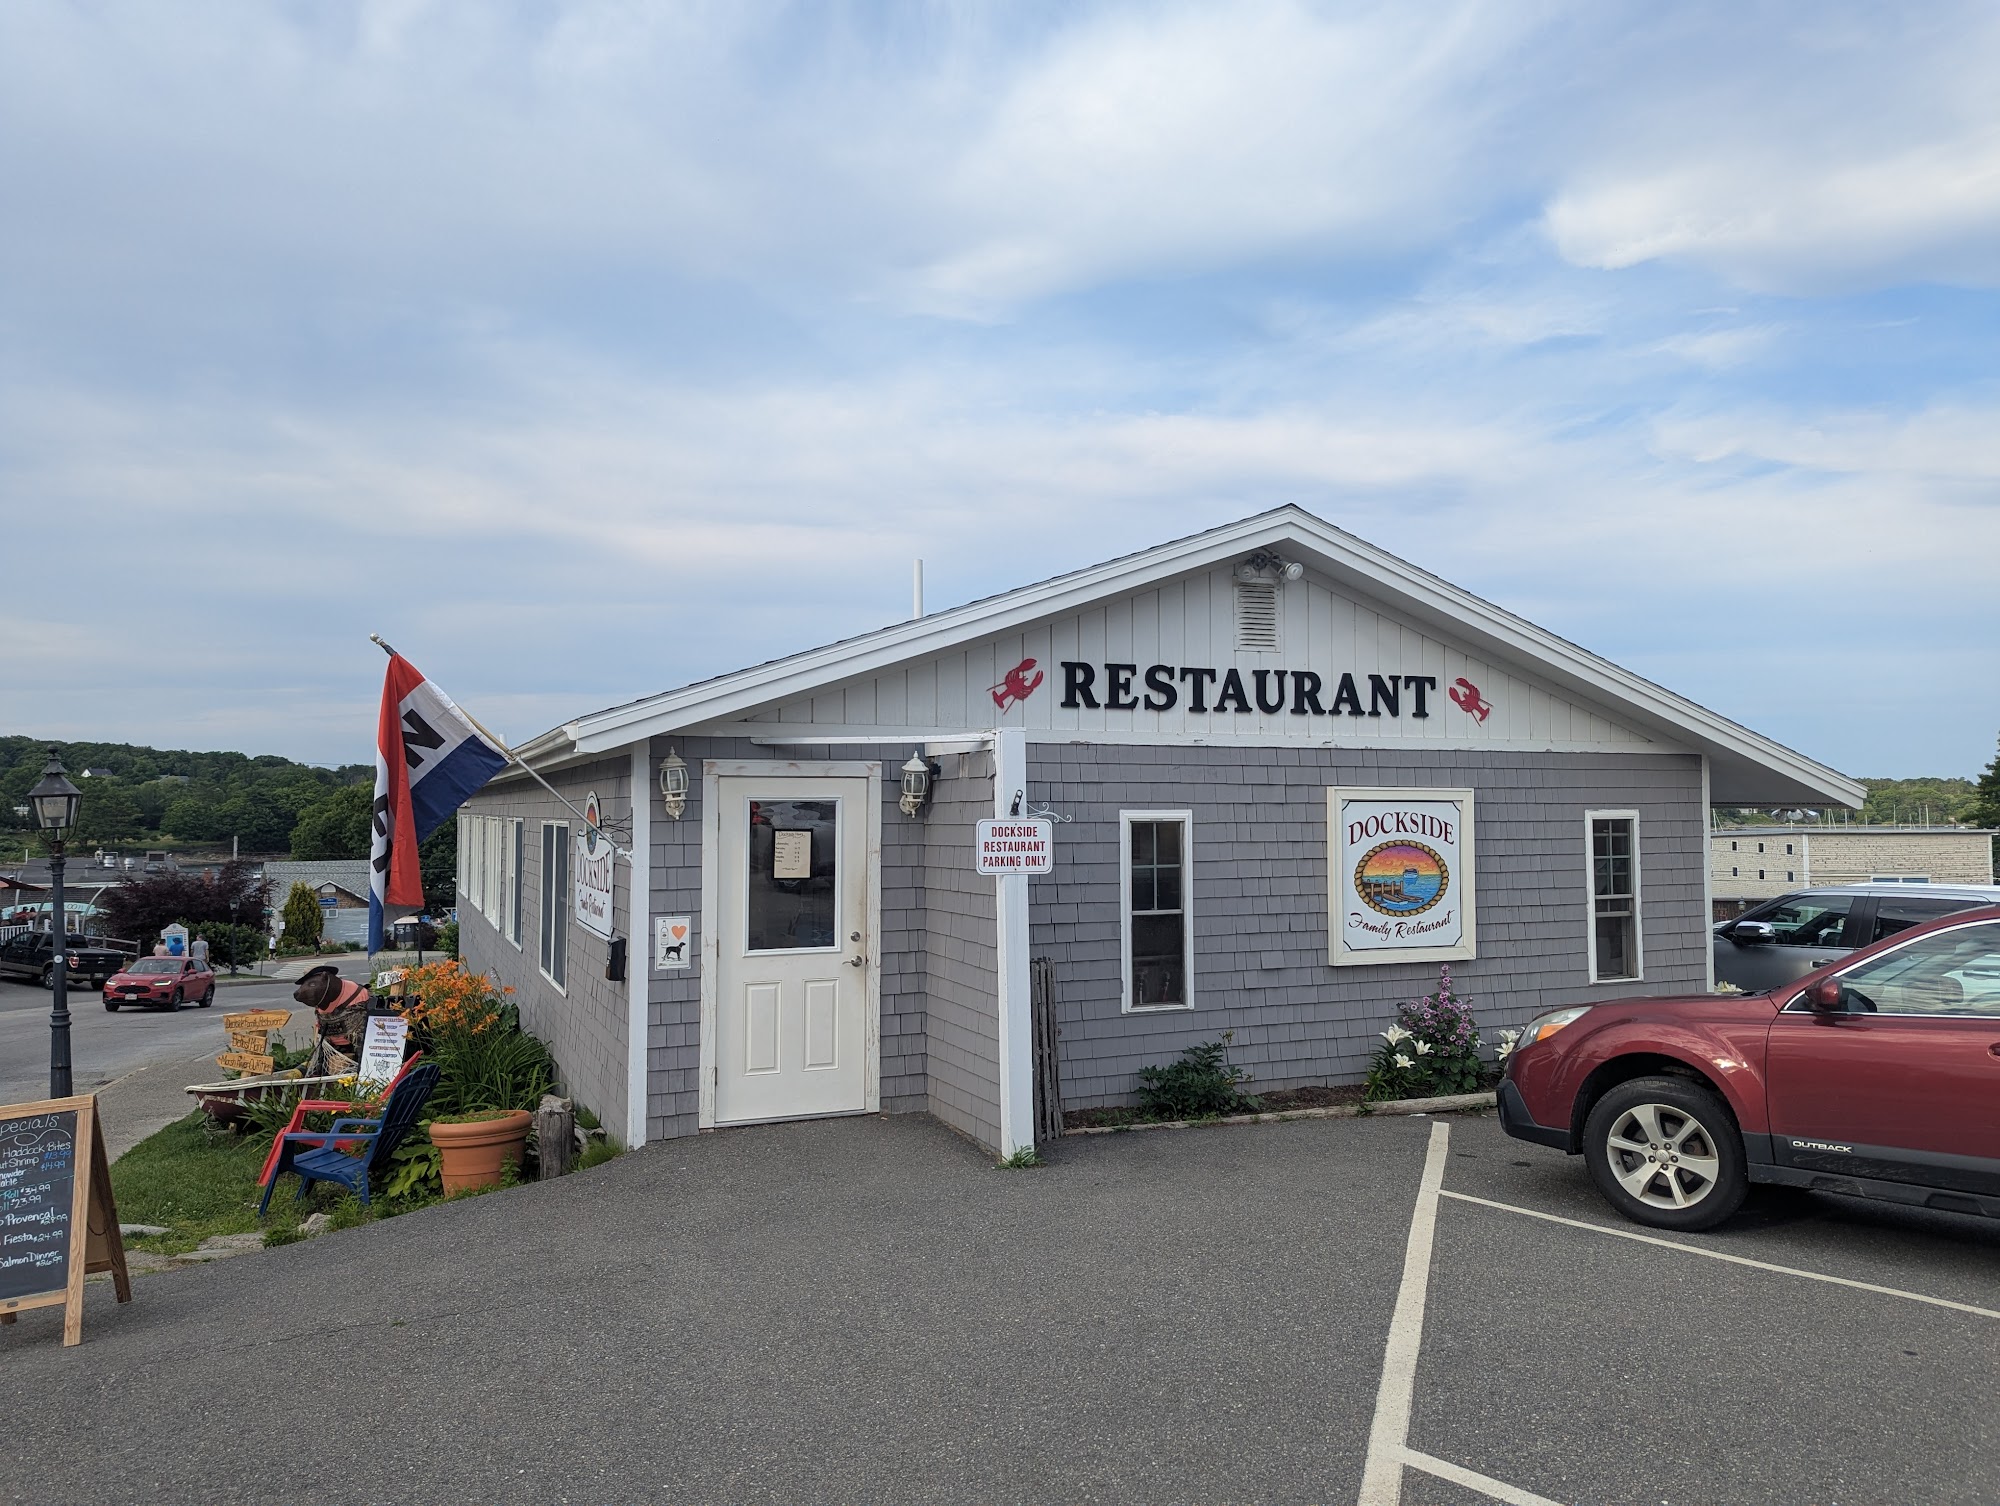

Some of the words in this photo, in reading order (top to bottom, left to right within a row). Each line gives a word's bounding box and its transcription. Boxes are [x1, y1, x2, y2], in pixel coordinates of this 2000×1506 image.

[1060, 661, 1436, 718] RESTAURANT
[991, 826, 1038, 838] DOCKSIDE
[1348, 811, 1455, 847] DOCKSIDE
[984, 840, 1046, 853] RESTAURANT
[983, 855, 1021, 867] PARKING
[1025, 855, 1047, 867] ONLY
[1348, 912, 1392, 941] Family
[1395, 909, 1455, 939] Restaurant
[3, 1144, 45, 1158] Haddock
[47, 1140, 71, 1152] Bites
[1792, 1140, 1852, 1153] OUTBACK
[9, 1157, 39, 1167] Shrimp
[41, 1160, 66, 1171] $14.99
[20, 1184, 51, 1196] $34.99
[4, 1233, 33, 1245] Fiesta
[33, 1230, 63, 1243] $24.99
[26, 1250, 59, 1262] Dinner
